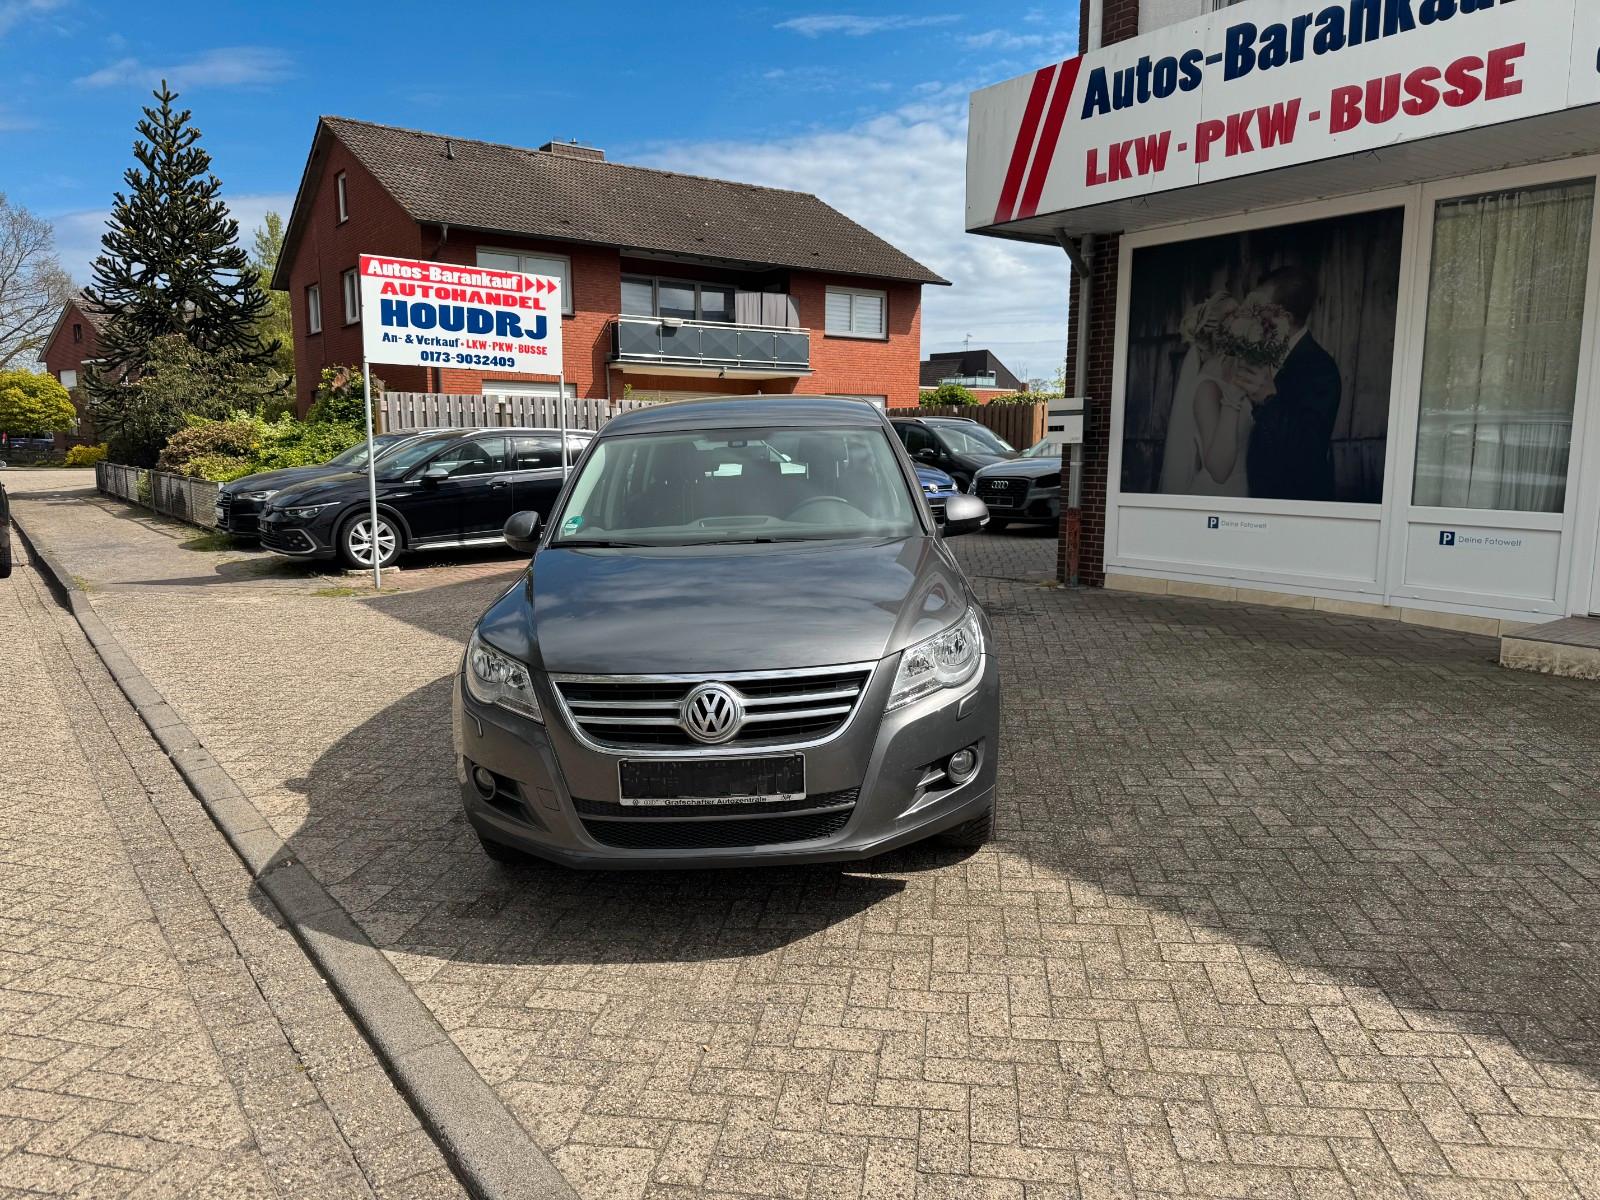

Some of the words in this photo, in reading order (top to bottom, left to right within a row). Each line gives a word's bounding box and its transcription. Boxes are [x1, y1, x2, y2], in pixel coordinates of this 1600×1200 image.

[1086, 130, 1171, 187] LKW
[1195, 98, 1301, 164] PKW
[1329, 42, 1526, 134] BUSSE
[367, 259, 520, 290] Autos-Barankauf
[380, 281, 546, 310] AUTOHANDEL
[380, 298, 548, 340] HOUDRJ
[405, 334, 414, 344] &
[416, 335, 460, 348] Verkauf
[466, 339, 488, 351] LKW
[492, 342, 514, 353] PKW
[518, 344, 548, 356] BUSSE
[420, 350, 515, 368] 0173-9032409
[1458, 535, 1482, 544] Deine
